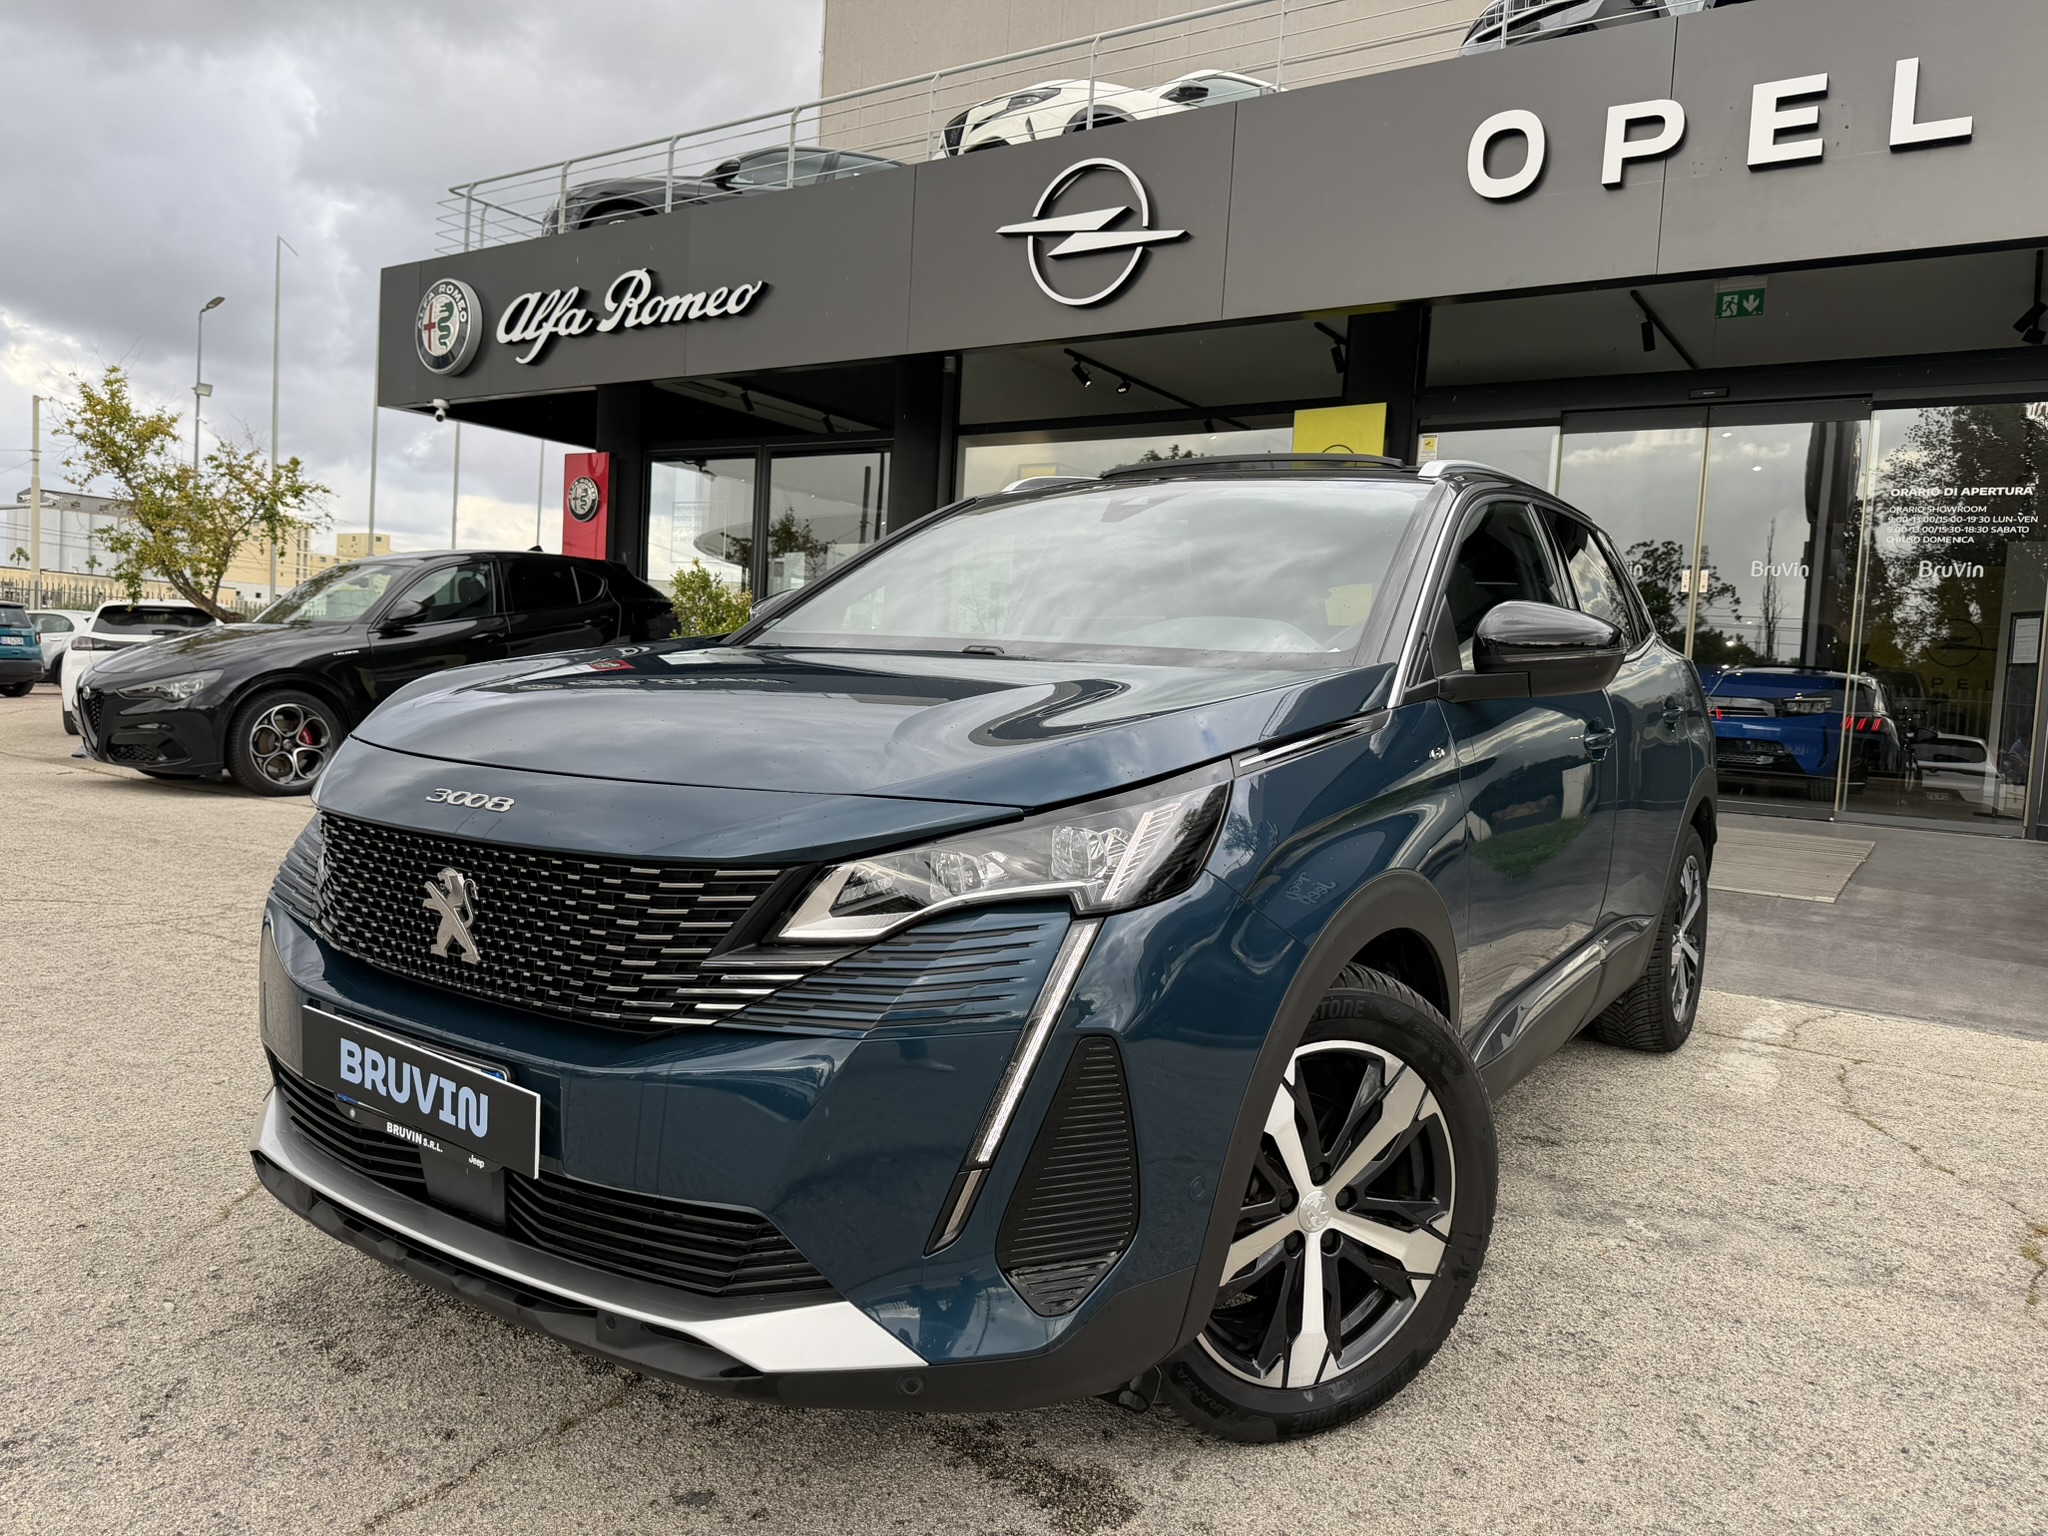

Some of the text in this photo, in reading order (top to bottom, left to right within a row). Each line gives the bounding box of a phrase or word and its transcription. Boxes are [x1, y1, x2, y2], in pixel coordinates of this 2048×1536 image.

[1467, 57, 1974, 199] OPEL
[438, 284, 467, 322] ROMEO
[496, 268, 763, 364] Alfa Romeo
[1890, 486, 2034, 497] ORARIO DI APERTURA
[1888, 505, 1987, 514] ORARIO SHOWROOM
[1992, 515, 2039, 524] LUN-VEN
[1990, 526, 2030, 534] SABATO
[1922, 536, 1975, 544] DOMENICA
[1750, 560, 1809, 577] BruVin
[1918, 560, 1984, 578] BruVin
[425, 787, 515, 813] 3008
[1311, 999, 1366, 1024] STONE
[340, 1037, 489, 1139] BRUVIN
[386, 1121, 443, 1153] BRUVIN S.R.L.
[468, 1154, 485, 1170] Jeep
